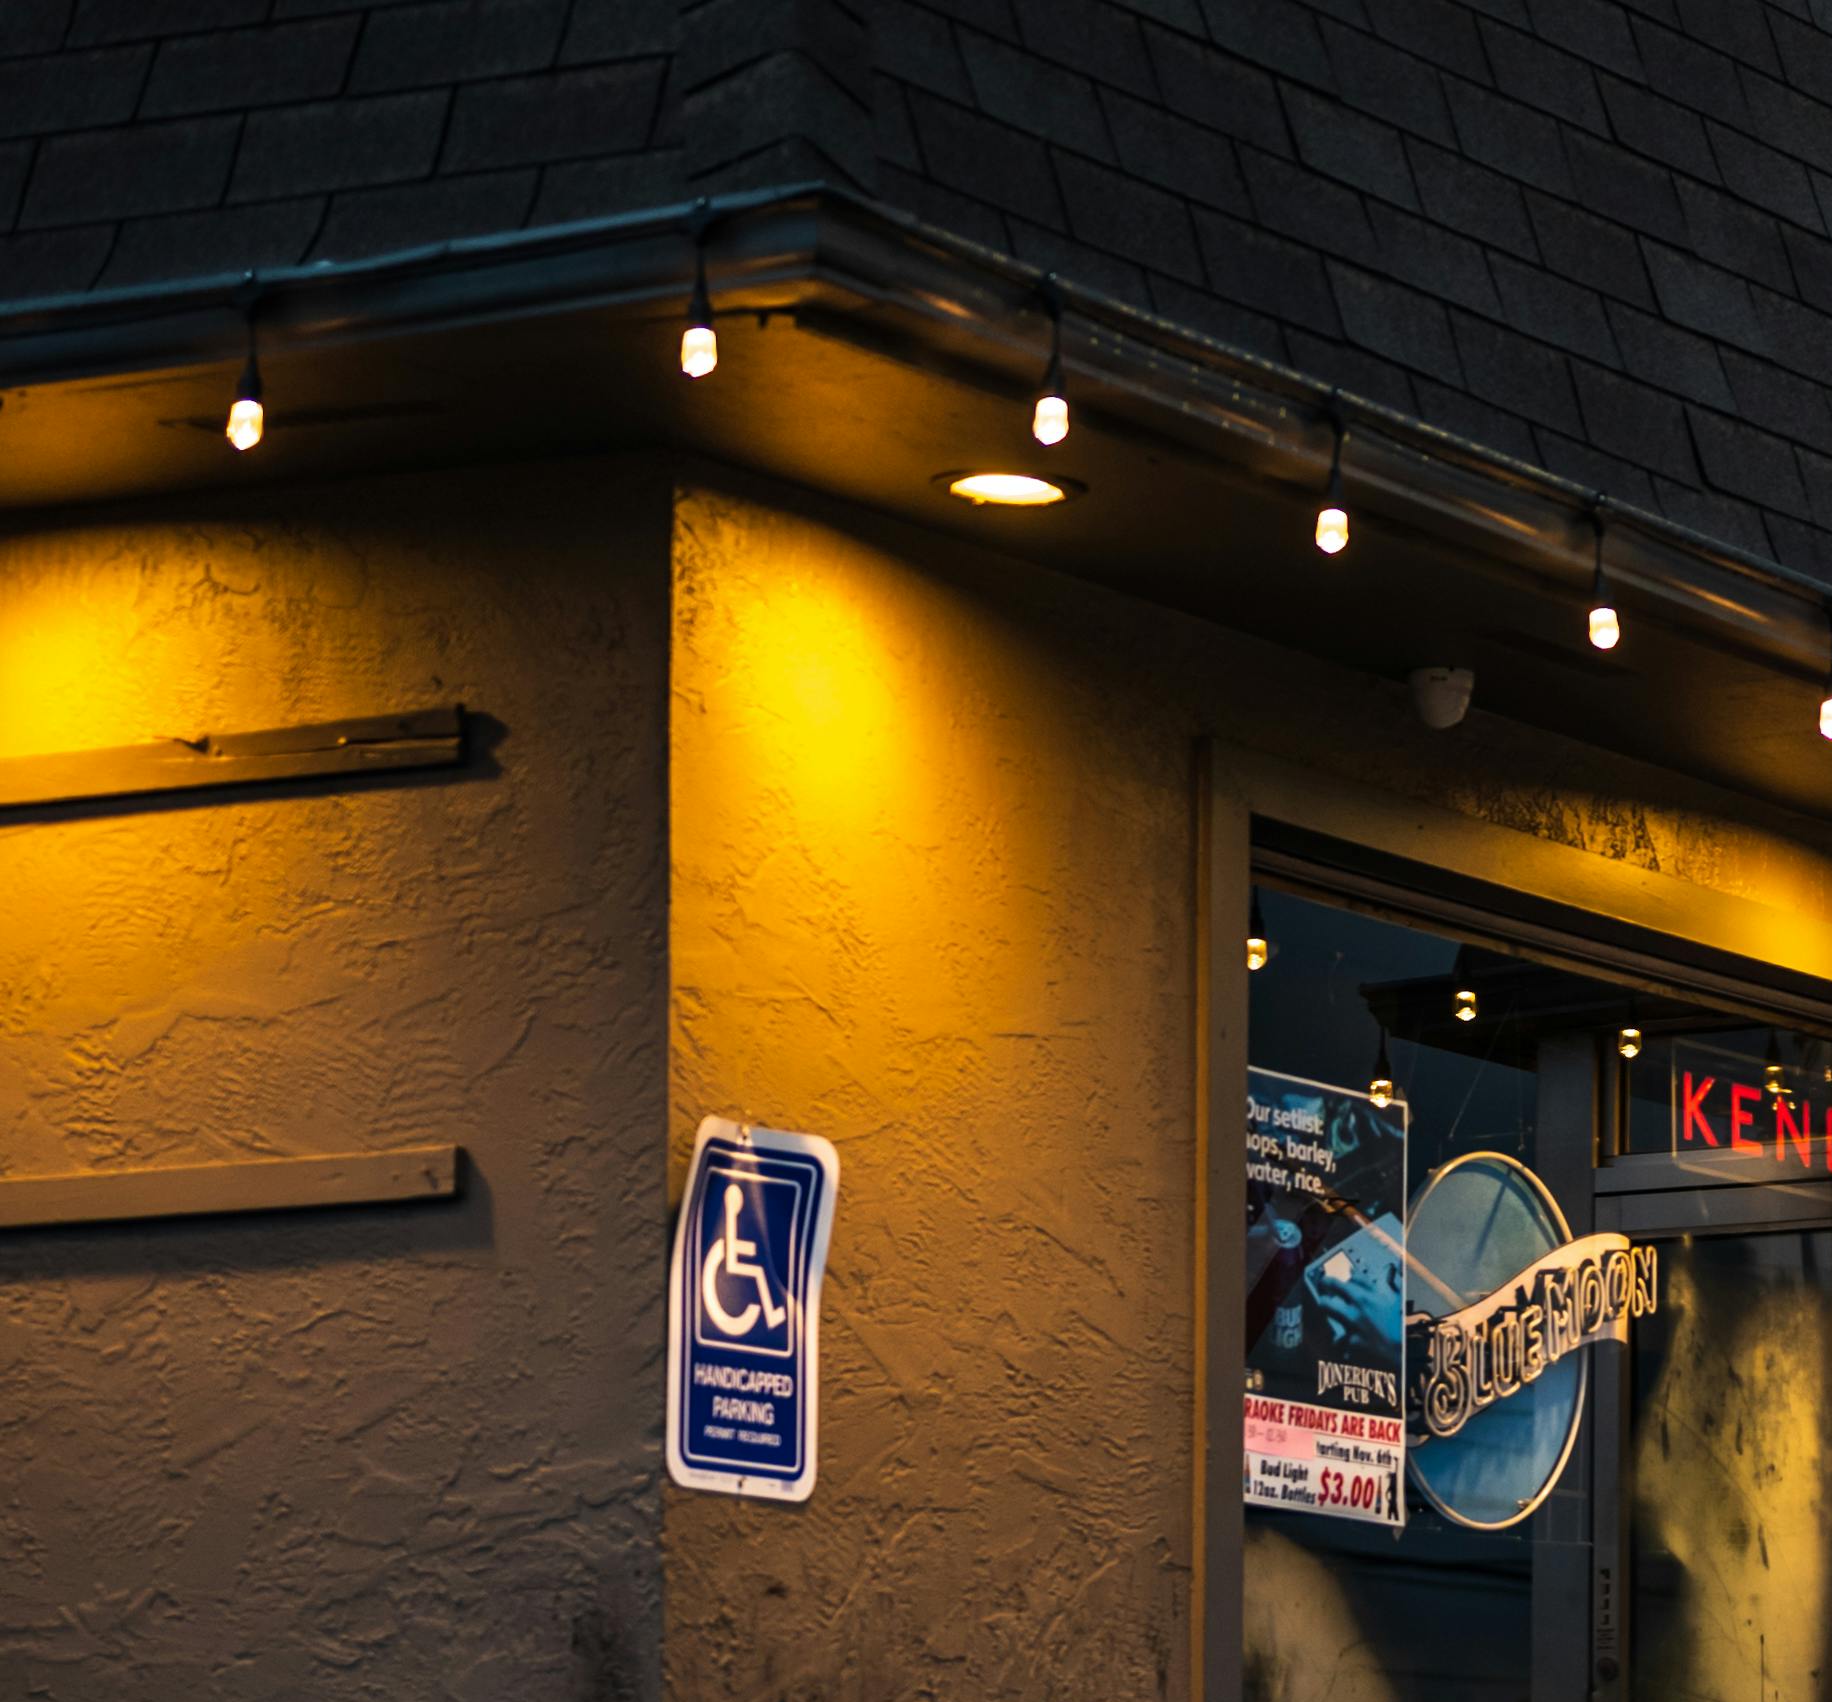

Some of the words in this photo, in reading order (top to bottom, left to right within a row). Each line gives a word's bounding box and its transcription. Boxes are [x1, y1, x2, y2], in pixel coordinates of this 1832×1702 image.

[1273, 1106, 1324, 1135] setlist:
[1286, 1135, 1336, 1173] barley,
[1294, 1167, 1325, 1194] rice.
[694, 1362, 794, 1398] HANDICAPPED
[1317, 1360, 1397, 1407] DONERICK'S
[1343, 1385, 1370, 1404] PUB
[712, 1395, 775, 1426] PARKING
[1288, 1405, 1338, 1433] FRIDAYS
[1341, 1414, 1365, 1437] ARE
[1368, 1418, 1402, 1443] BACK
[1260, 1460, 1281, 1476] Bud
[1283, 1461, 1309, 1482] Light
[1281, 1484, 1316, 1504] Bottles
[1318, 1466, 1374, 1509] $3.00
